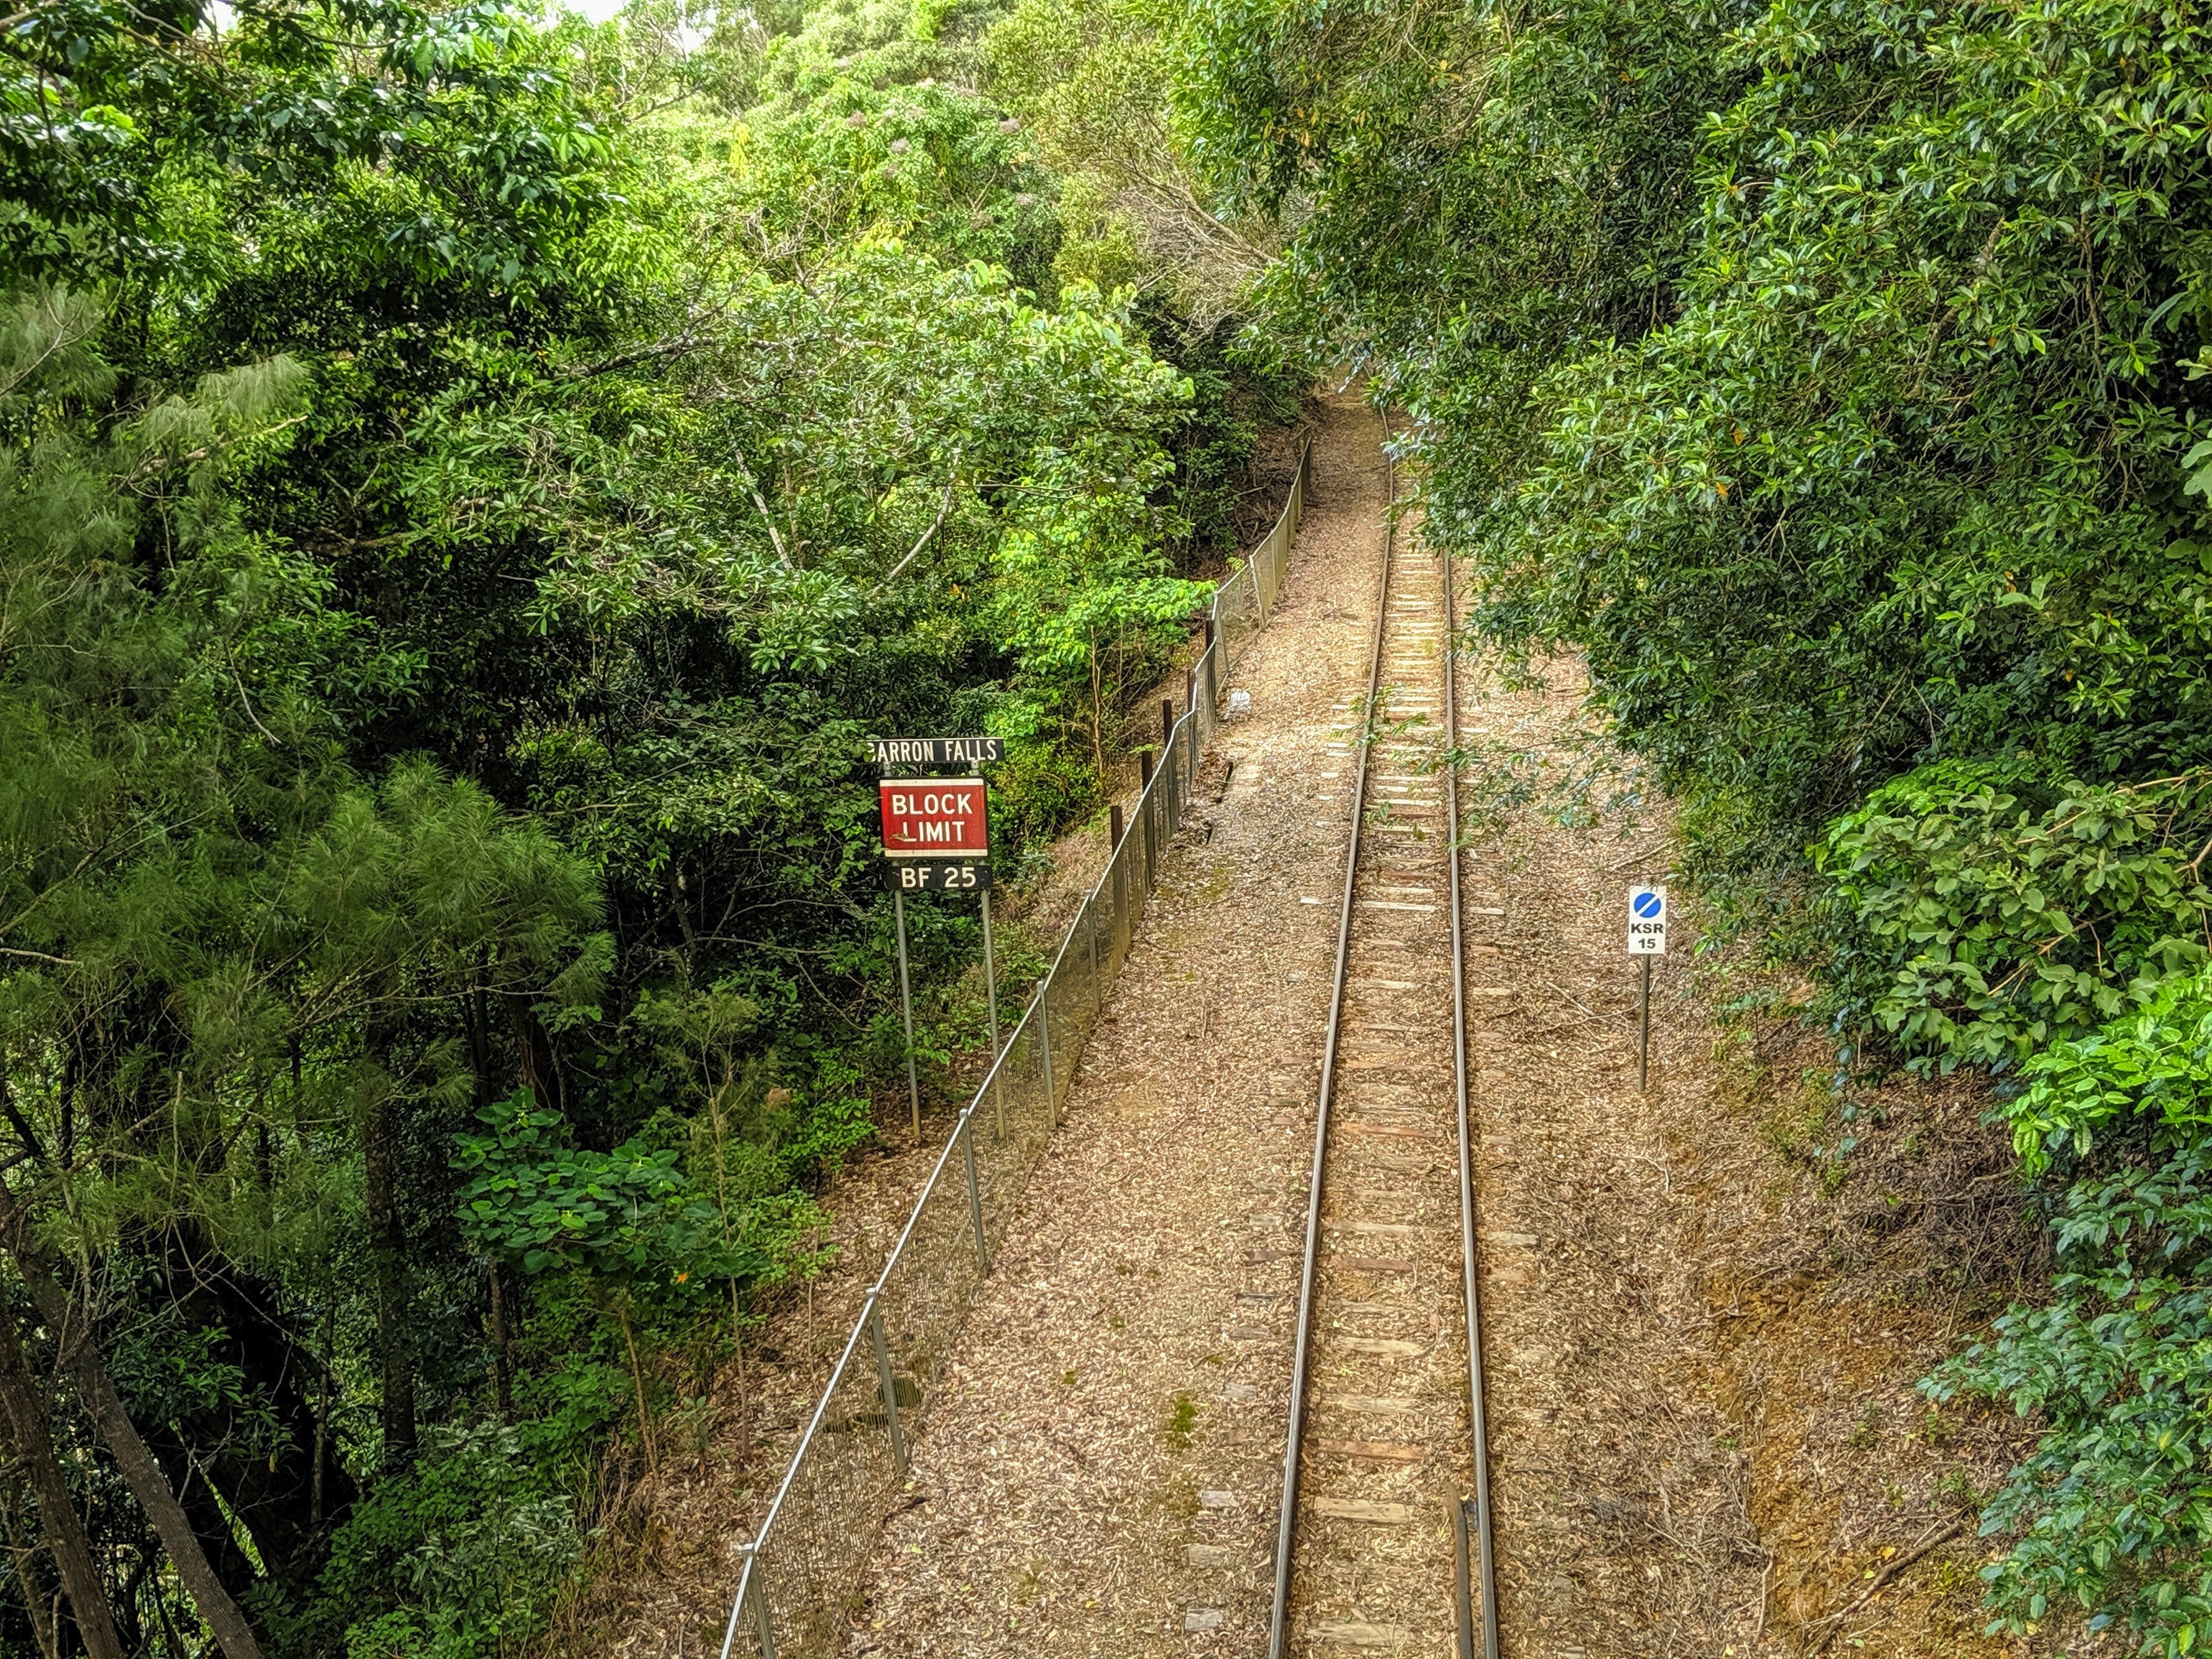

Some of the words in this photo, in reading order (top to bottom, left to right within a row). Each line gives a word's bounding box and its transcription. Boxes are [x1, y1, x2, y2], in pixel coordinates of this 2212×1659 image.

[945, 740, 997, 761] FALLS
[891, 794, 973, 815] BLOCK
[902, 821, 965, 842] LIMIT
[901, 867, 931, 888] BF
[944, 867, 977, 888] 25
[1631, 923, 1664, 933] KSR
[1638, 938, 1656, 949] 15
